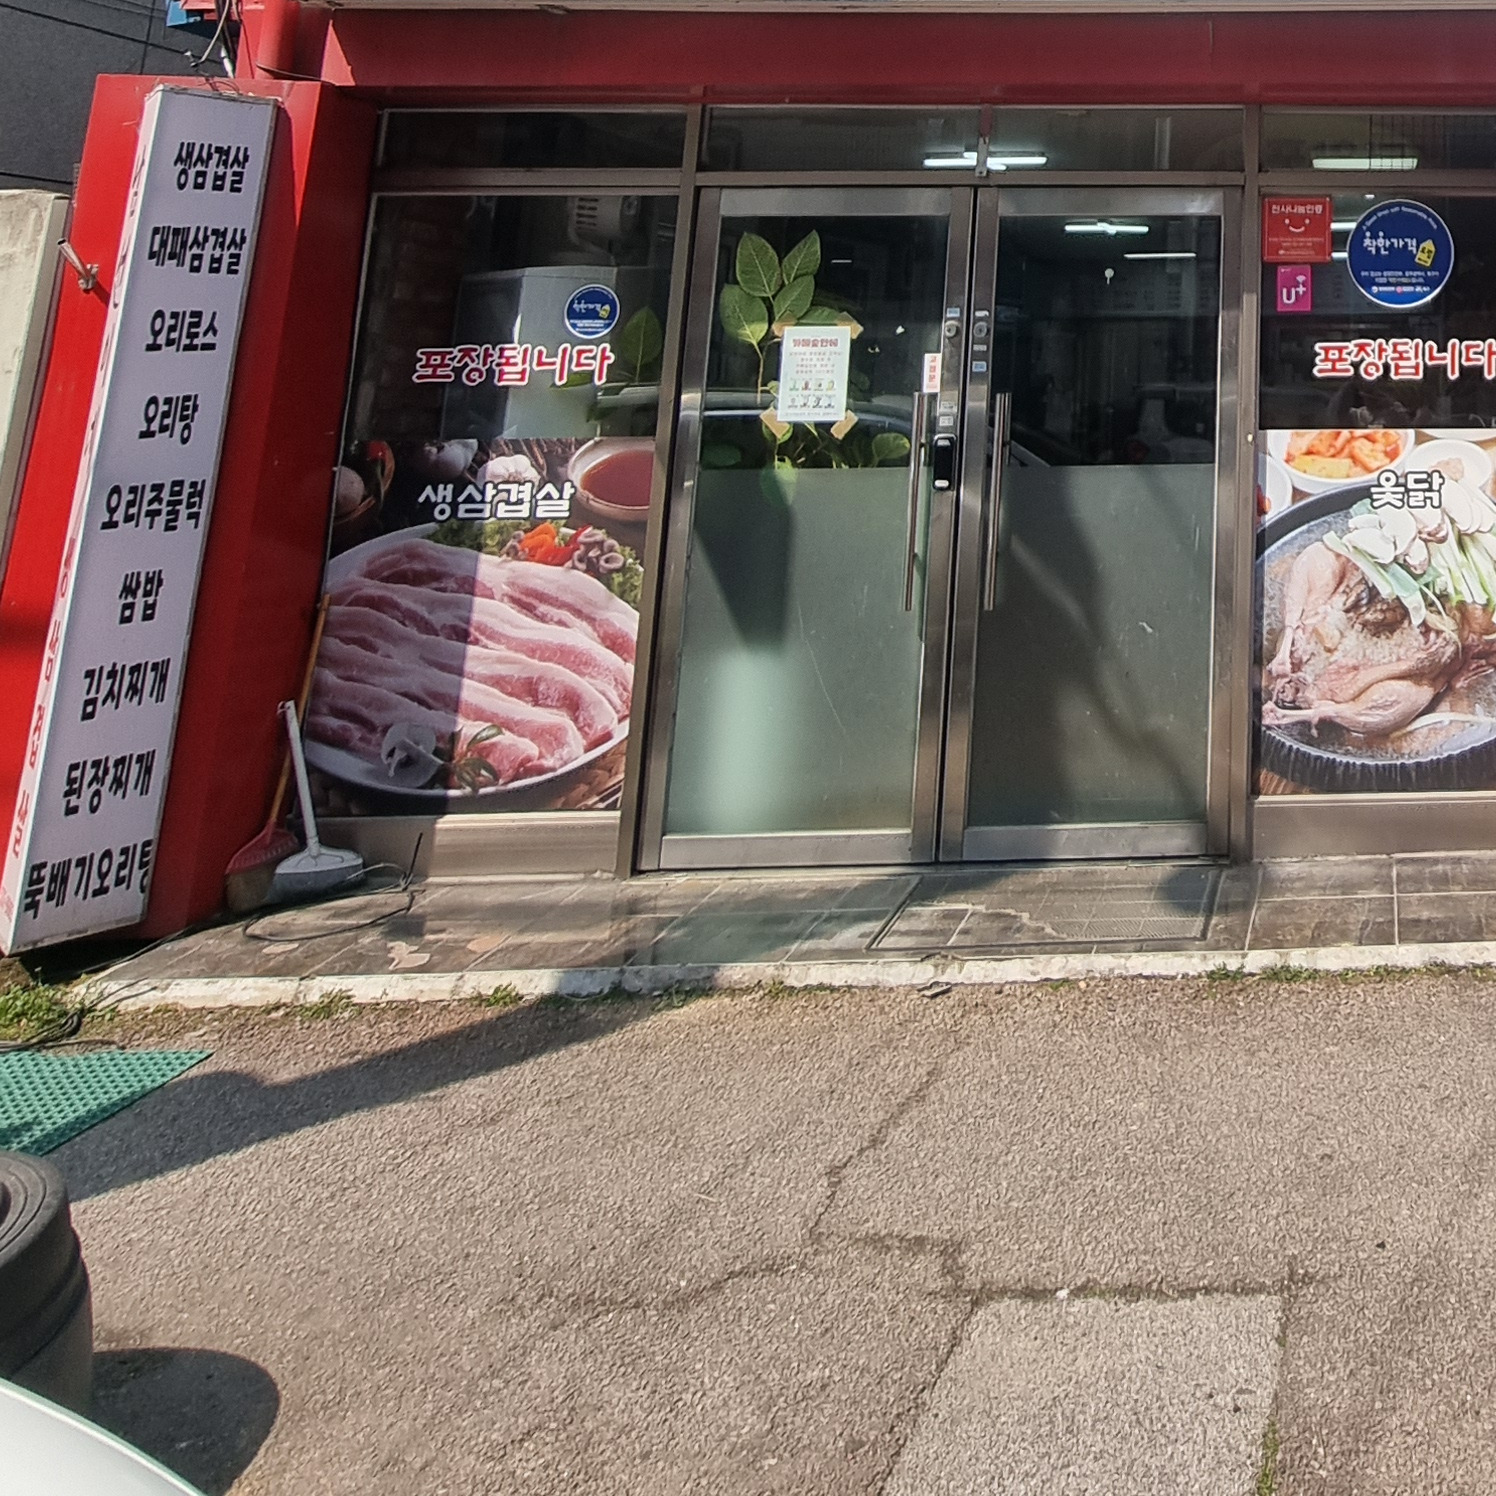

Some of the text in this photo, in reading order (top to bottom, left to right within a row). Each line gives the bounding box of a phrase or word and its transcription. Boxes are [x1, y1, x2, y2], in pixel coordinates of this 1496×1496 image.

[173, 141, 249, 194] 생삼겹살
[148, 225, 247, 276] 대패삼겹살
[145, 309, 219, 353] 오리로스
[412, 342, 615, 387] 포장됩니다
[138, 393, 199, 445] 오리탕
[100, 479, 205, 532] 오리주물럭
[418, 480, 577, 520] 생삼겹살
[1370, 470, 1445, 510] 옻닭
[118, 568, 164, 625] 쌈밥
[80, 657, 171, 722] 김치찌개
[62, 749, 157, 817] 된장찌개
